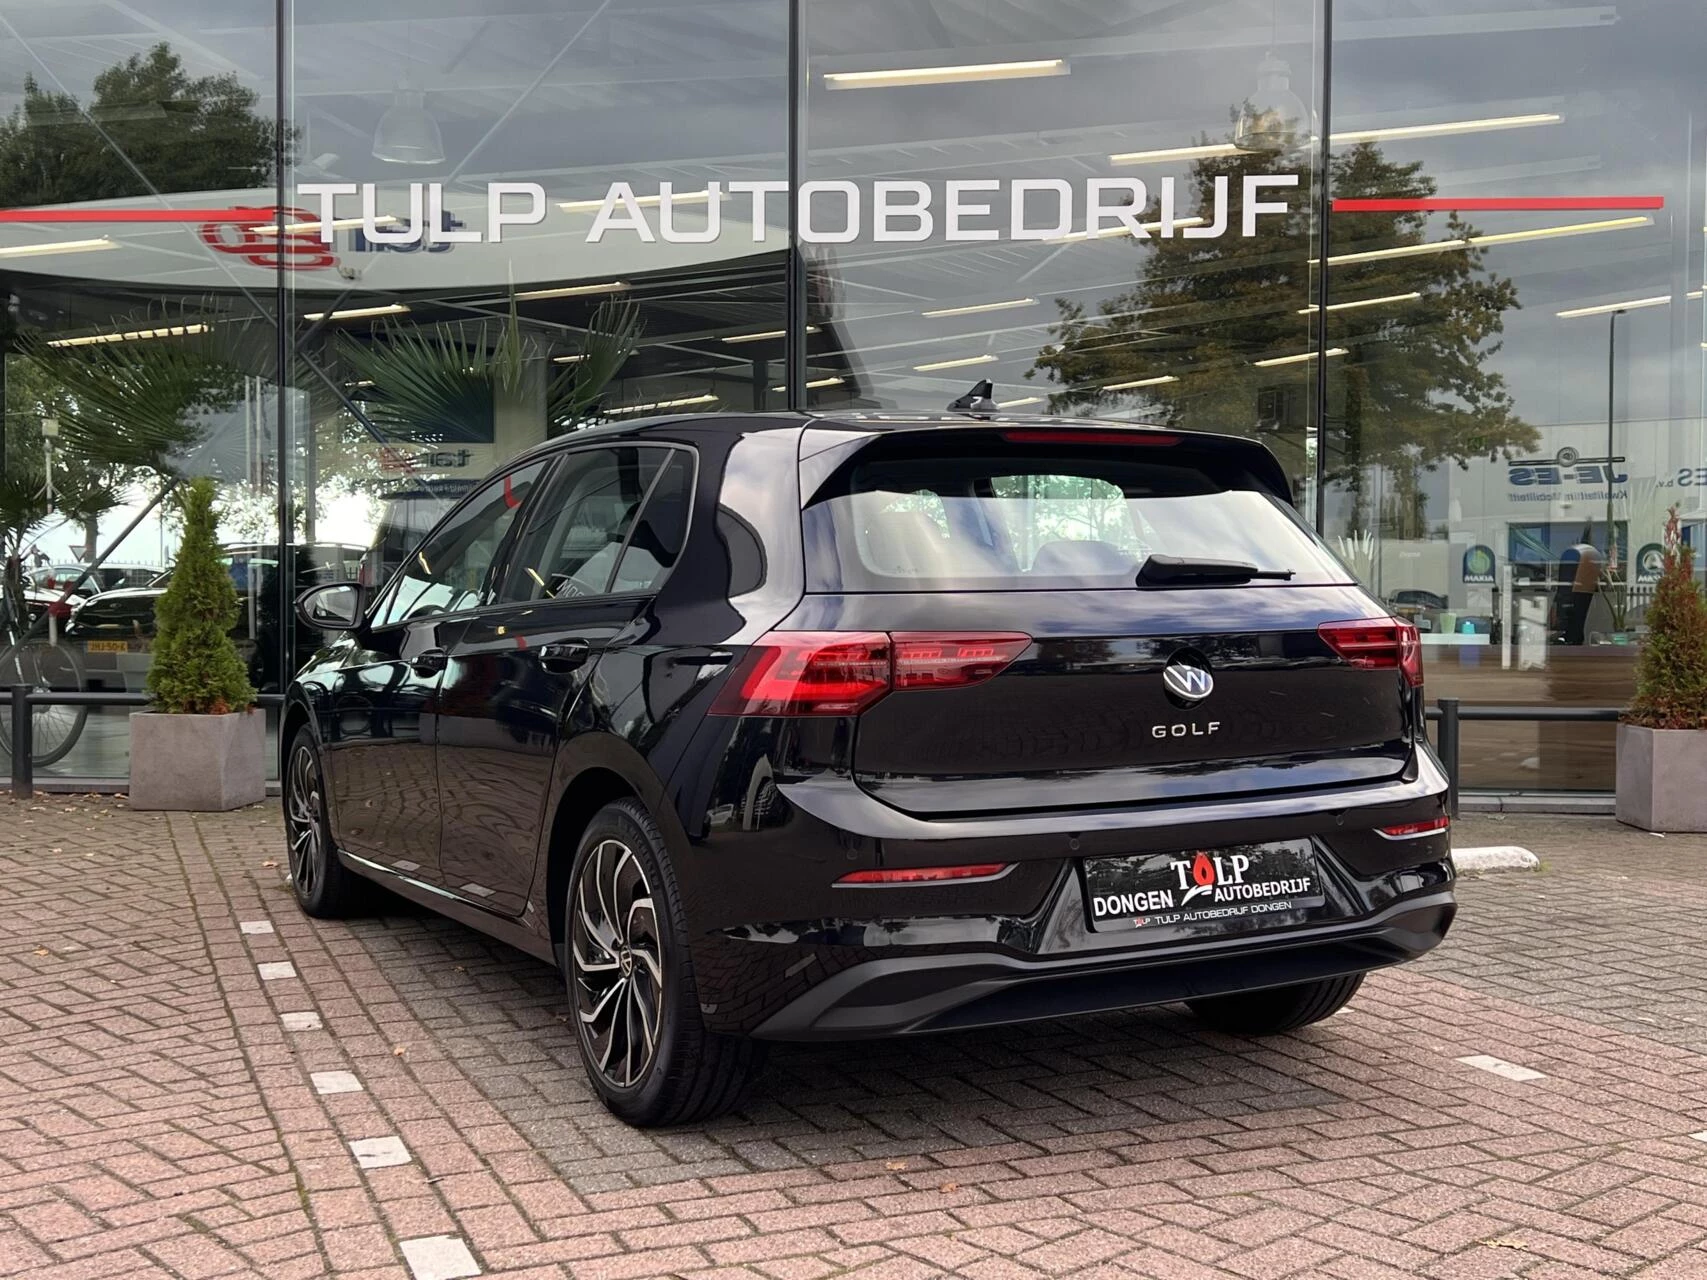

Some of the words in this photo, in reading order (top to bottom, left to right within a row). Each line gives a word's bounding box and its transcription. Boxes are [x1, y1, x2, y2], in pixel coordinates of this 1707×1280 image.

[297, 183, 548, 244] TULP
[585, 173, 1300, 244] AUTOBEDRIJF
[1151, 721, 1221, 738] GOLF
[1093, 888, 1173, 917] DONGEN
[1214, 877, 1311, 903] AUTOBEDRIJF
[1154, 913, 1180, 925] TULP
[1183, 905, 1249, 922] AUTOBEDRIJF
[1251, 901, 1292, 916] DONGEN
